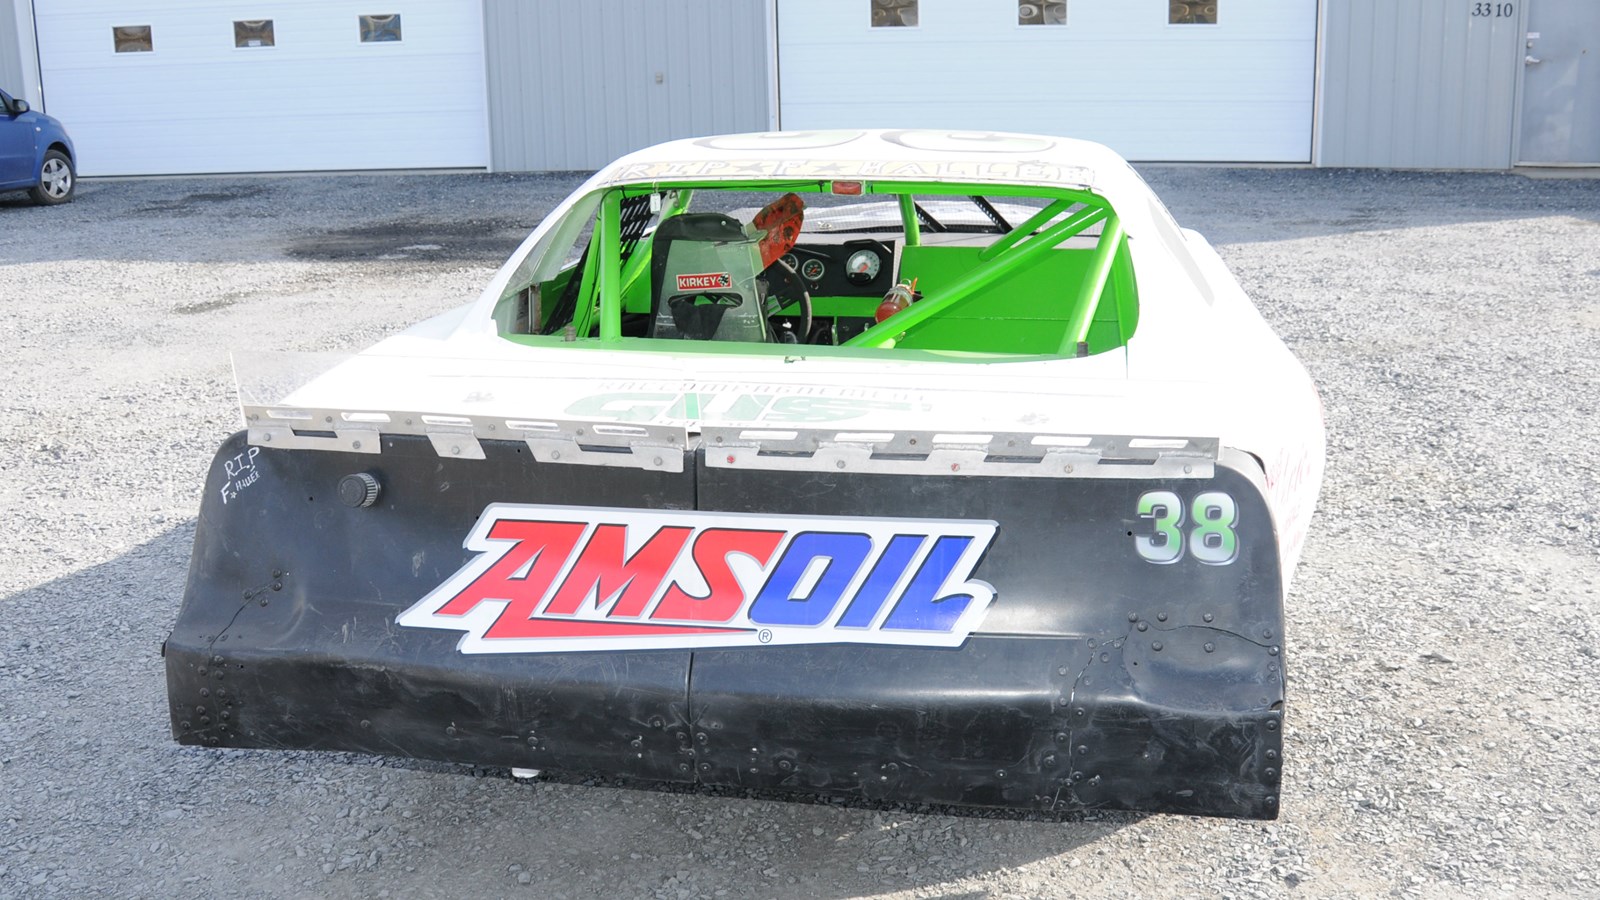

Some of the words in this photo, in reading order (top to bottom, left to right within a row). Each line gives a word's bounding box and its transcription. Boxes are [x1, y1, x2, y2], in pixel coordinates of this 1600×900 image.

[1471, 2, 1514, 18] 3310
[679, 276, 717, 288] KIRKEY
[1135, 490, 1240, 566] 38
[432, 517, 976, 639] AMSOIL
